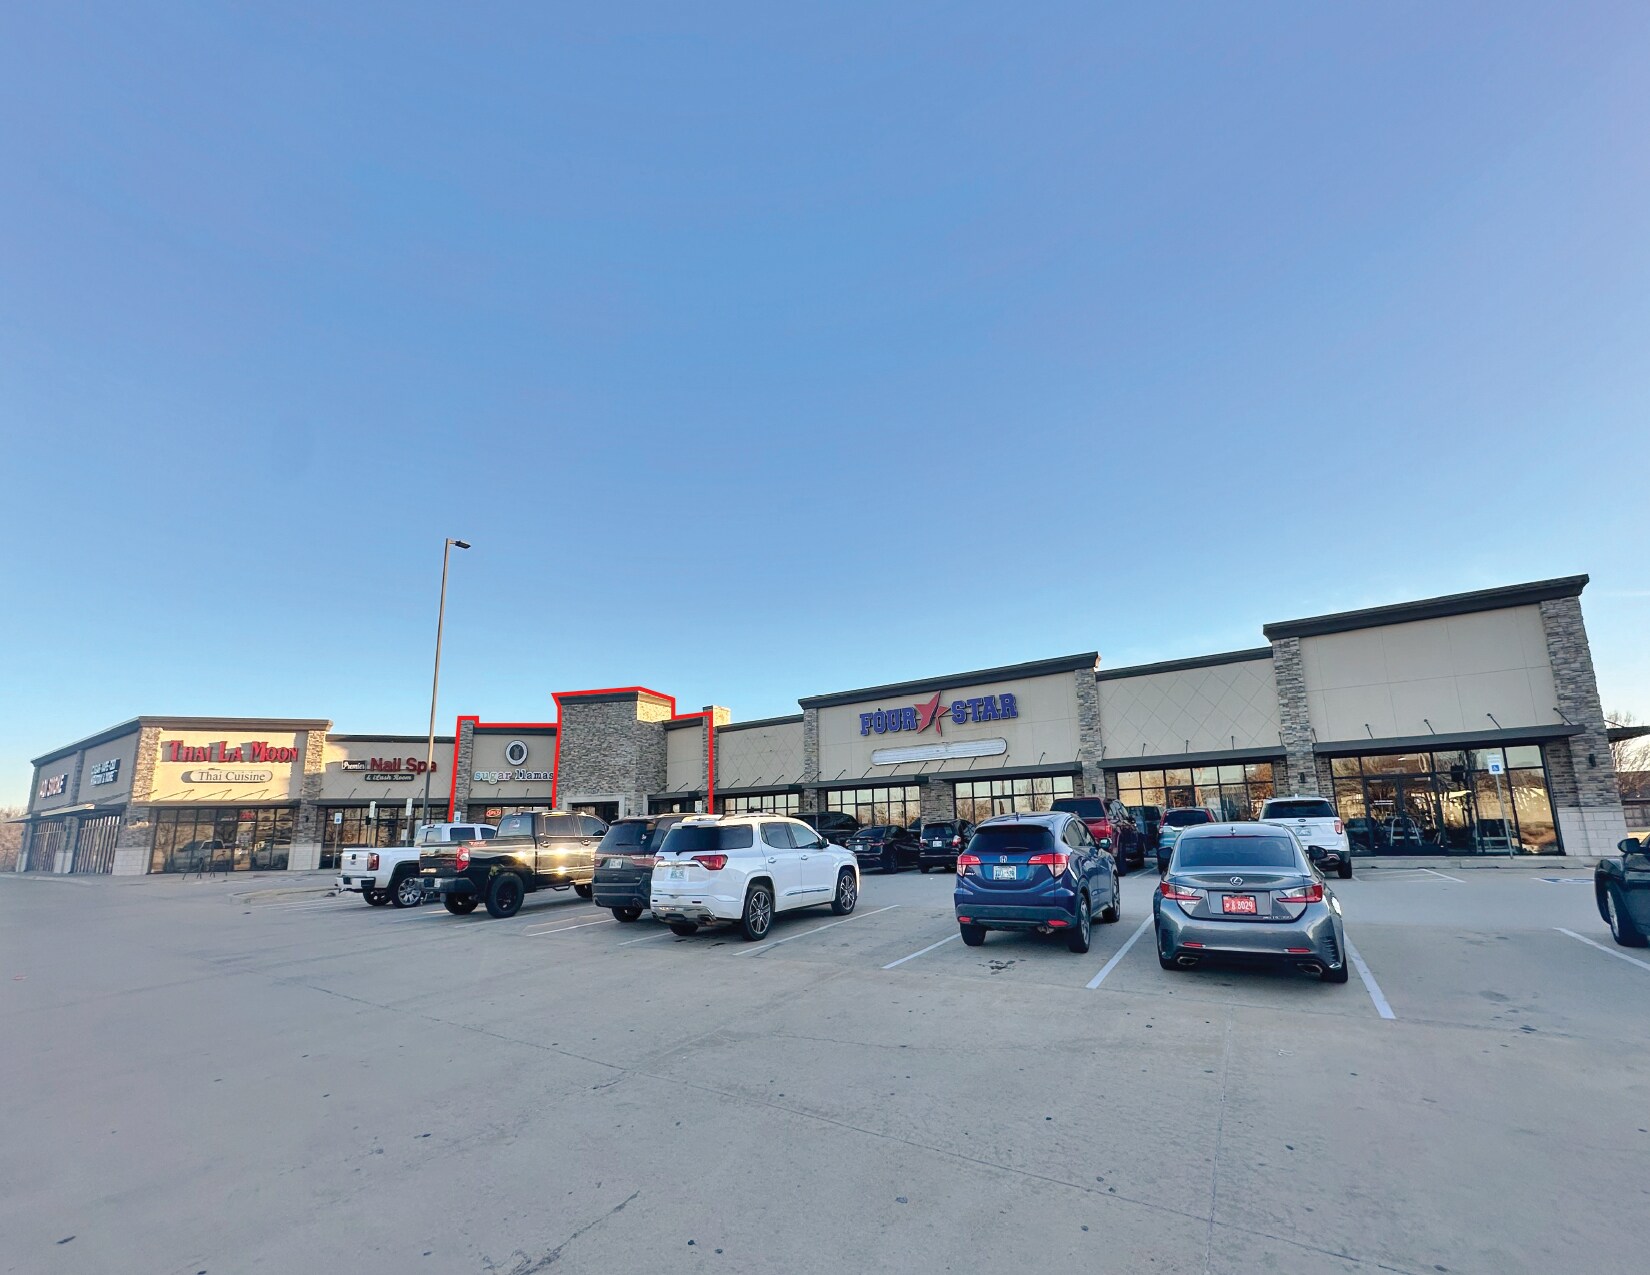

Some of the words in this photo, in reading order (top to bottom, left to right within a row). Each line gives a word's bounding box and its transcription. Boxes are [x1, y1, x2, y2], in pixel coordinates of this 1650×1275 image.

[860, 707, 917, 736] FOUR
[951, 693, 1018, 724] STAR
[370, 758, 401, 772] Nail
[199, 771, 222, 781] Thai
[225, 771, 266, 781] Cuisine
[474, 771, 512, 785] sugar
[515, 769, 554, 780] llamas
